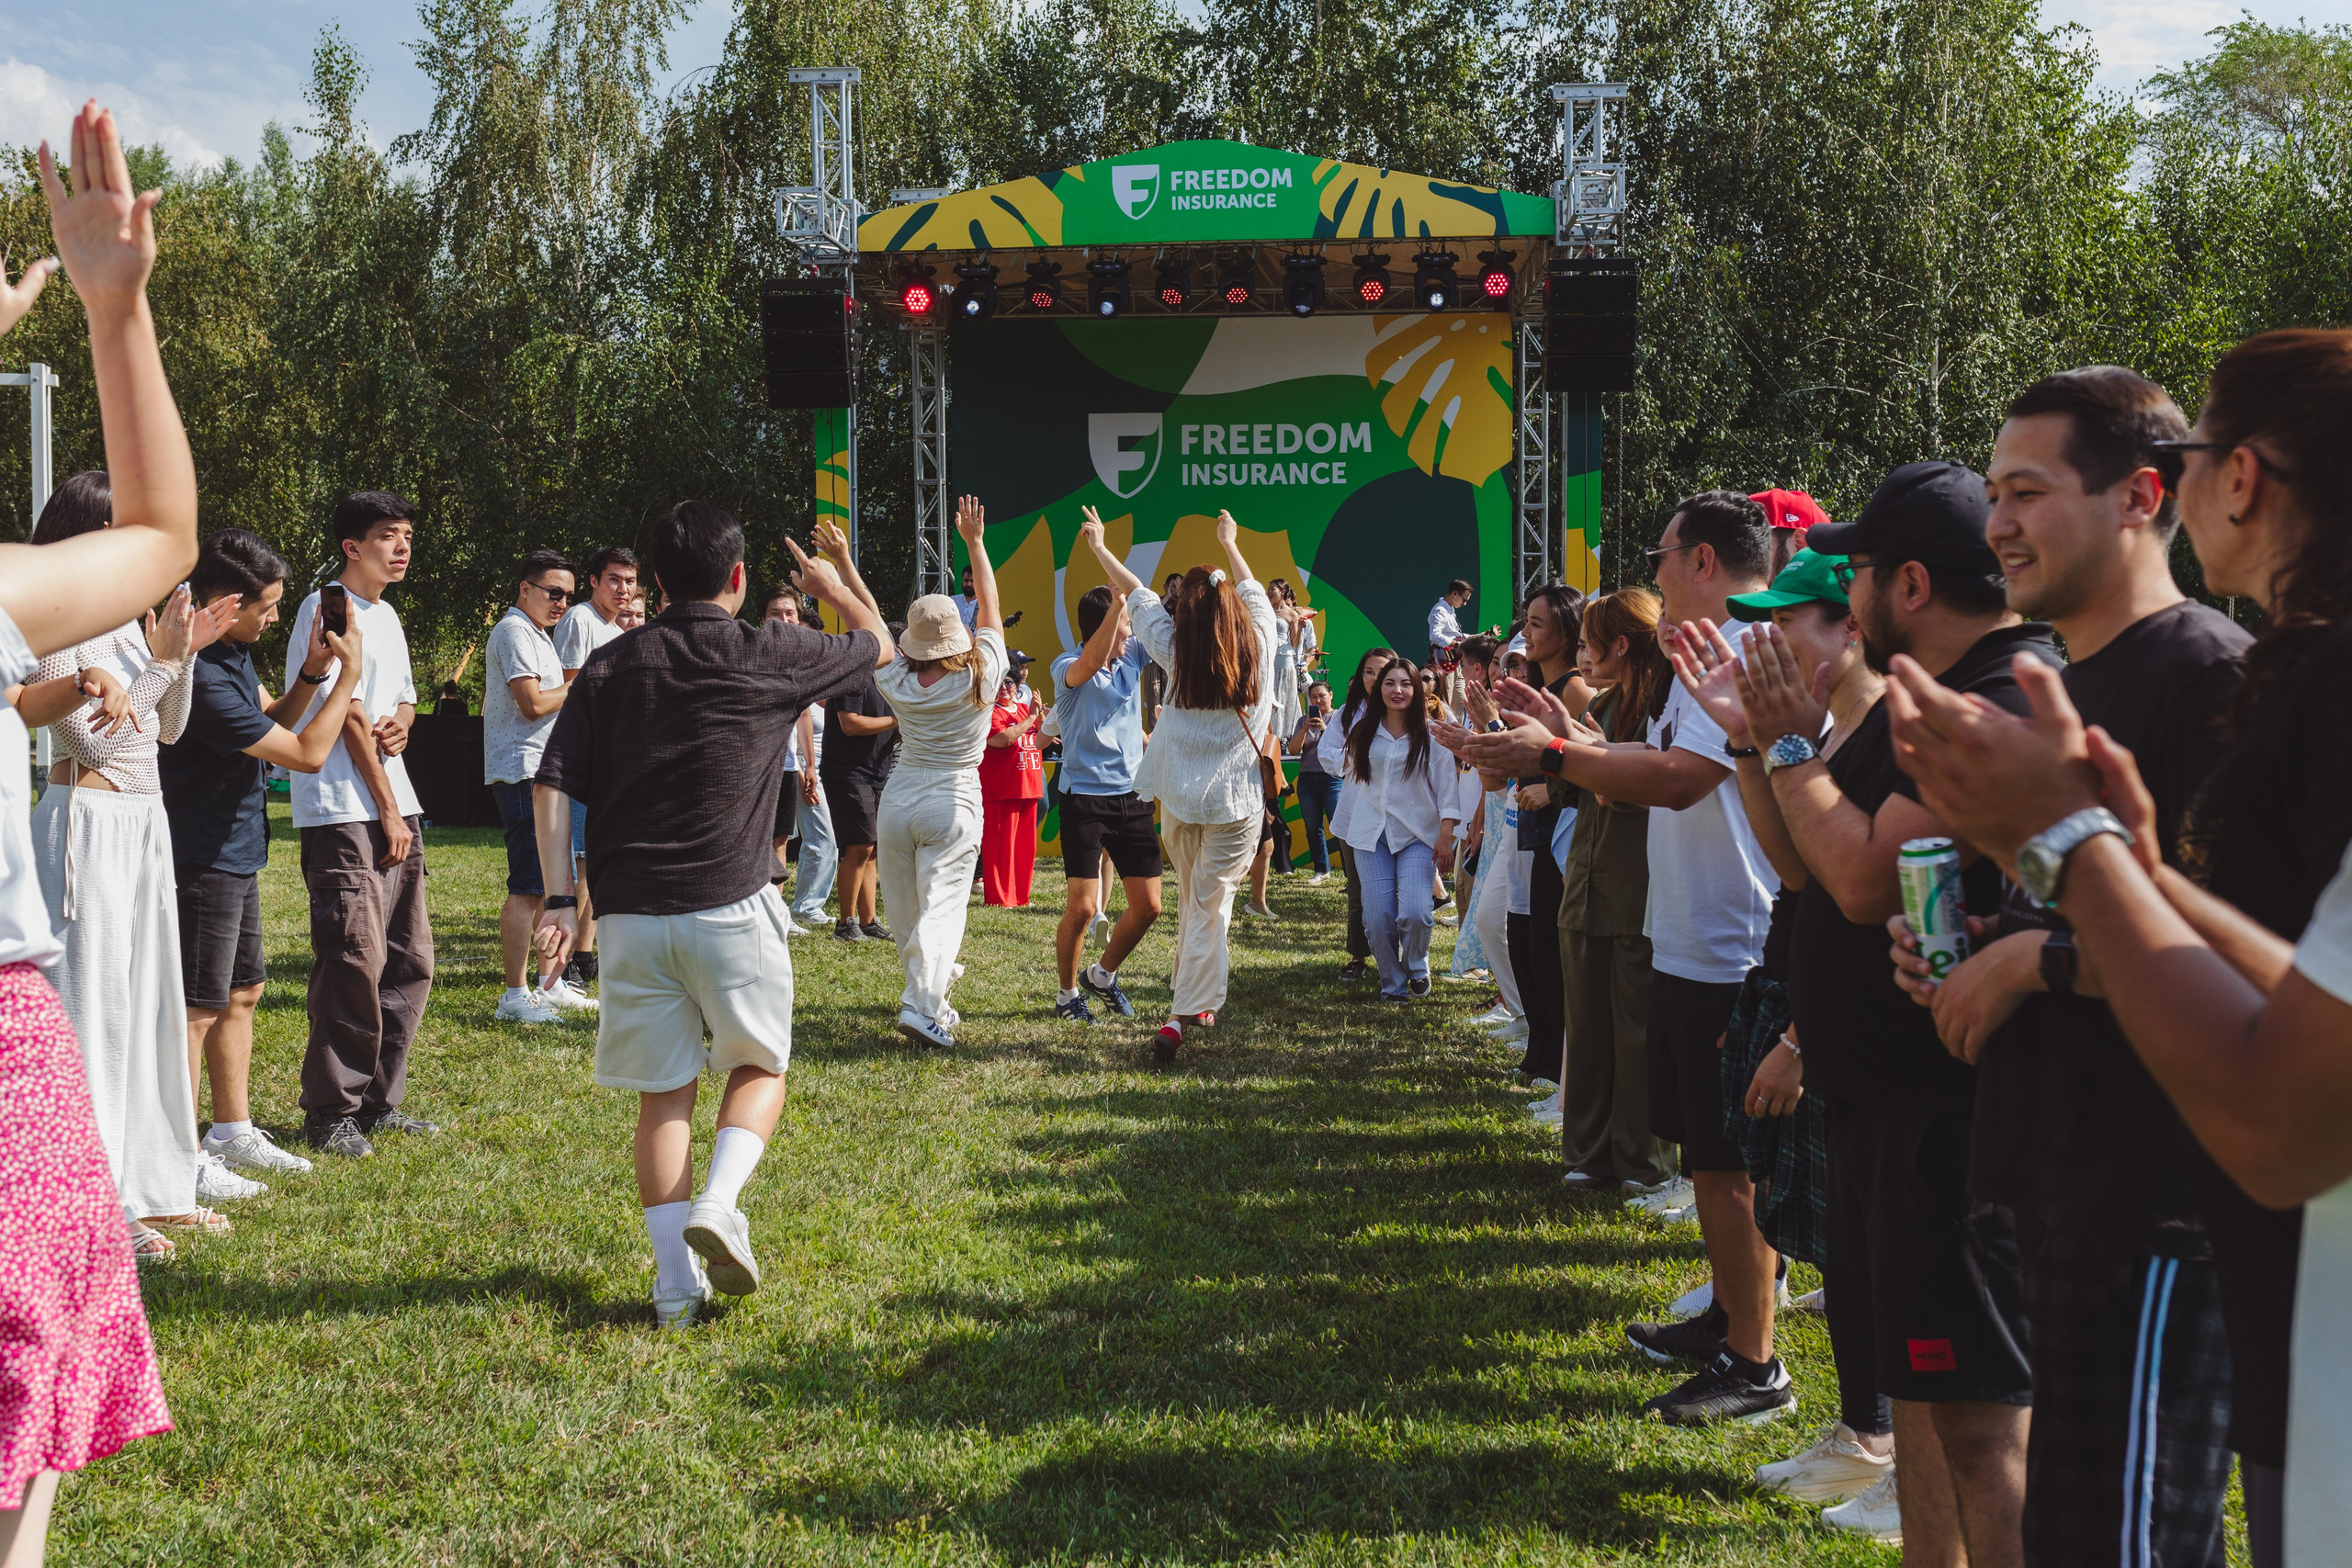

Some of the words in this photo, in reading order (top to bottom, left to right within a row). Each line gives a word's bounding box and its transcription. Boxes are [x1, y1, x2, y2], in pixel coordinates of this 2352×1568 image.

[1171, 168, 1293, 191] FREEDOM
[1171, 193, 1277, 210] INSURANCE
[1182, 423, 1372, 455] FREEDOM
[1182, 462, 1347, 486] INSURANCE
[666, 1291, 683, 1299] NIKE
